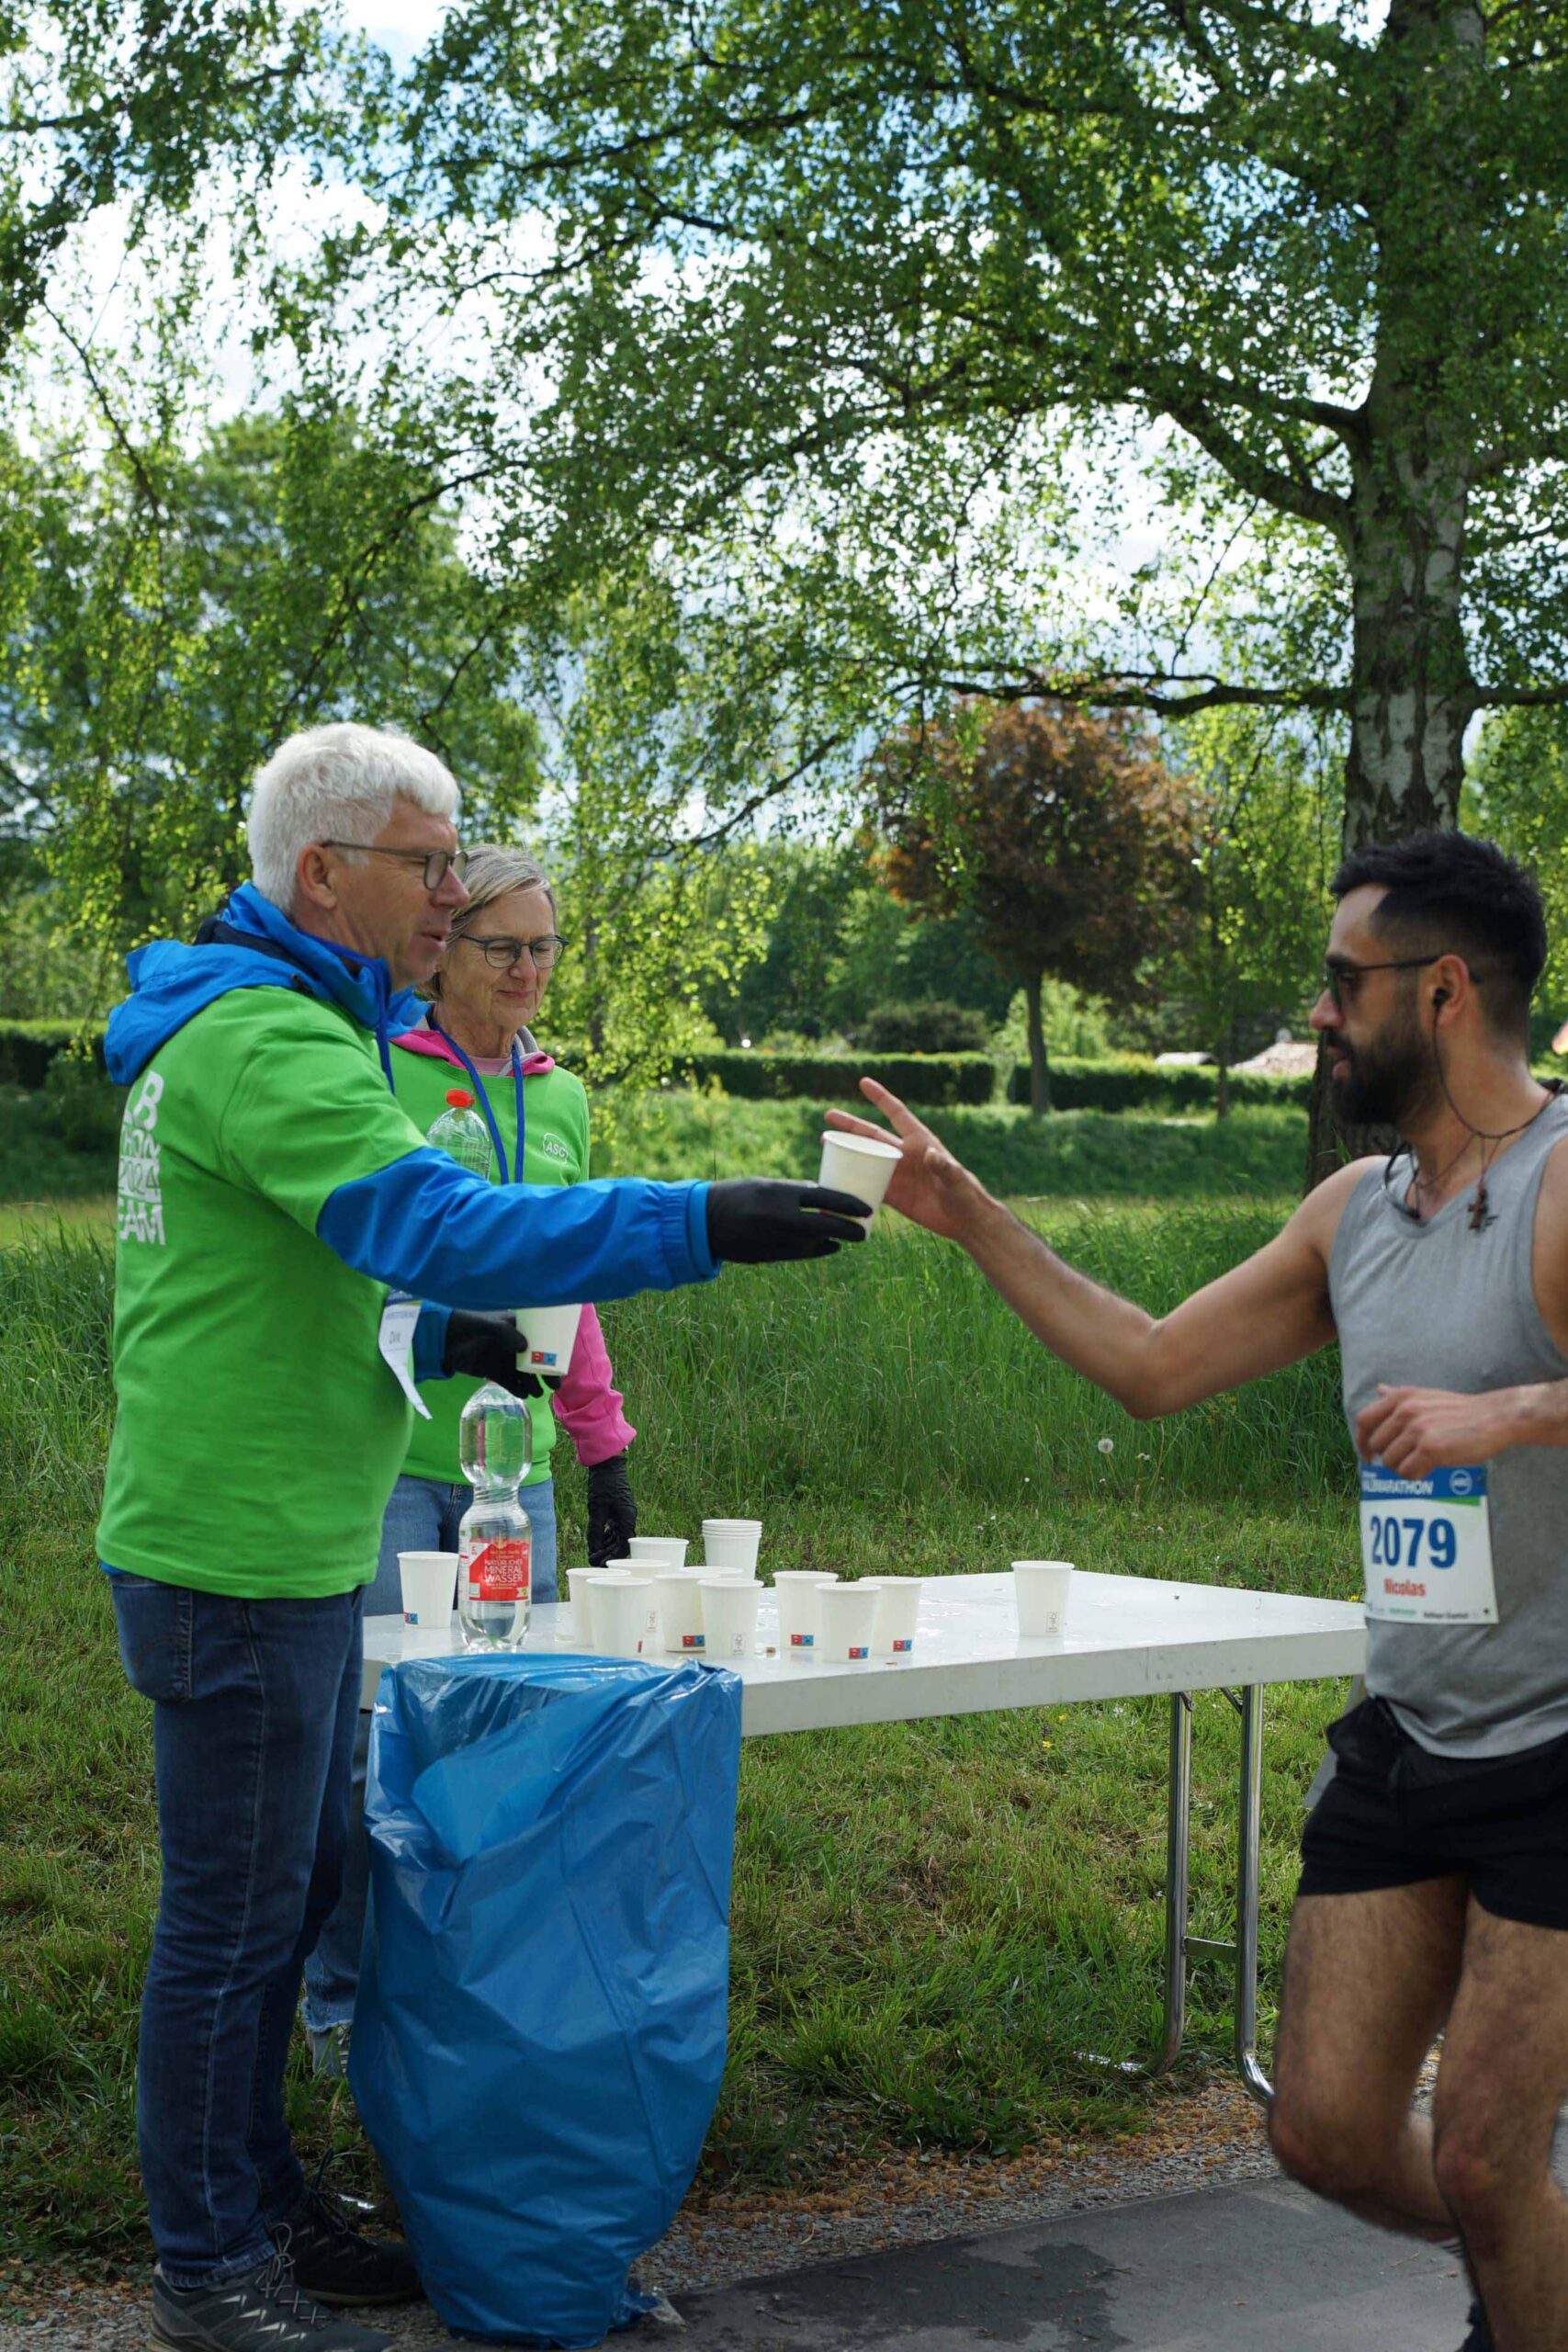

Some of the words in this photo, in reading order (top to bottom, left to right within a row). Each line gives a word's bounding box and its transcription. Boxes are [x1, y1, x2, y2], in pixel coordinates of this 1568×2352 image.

[546, 1142, 567, 1158] ASC
[1370, 1515, 1458, 1569] 2079
[484, 1566, 525, 1575] MINERAL
[484, 1574, 524, 1583] WASSER
[1383, 1577, 1427, 1597] Nicolas
